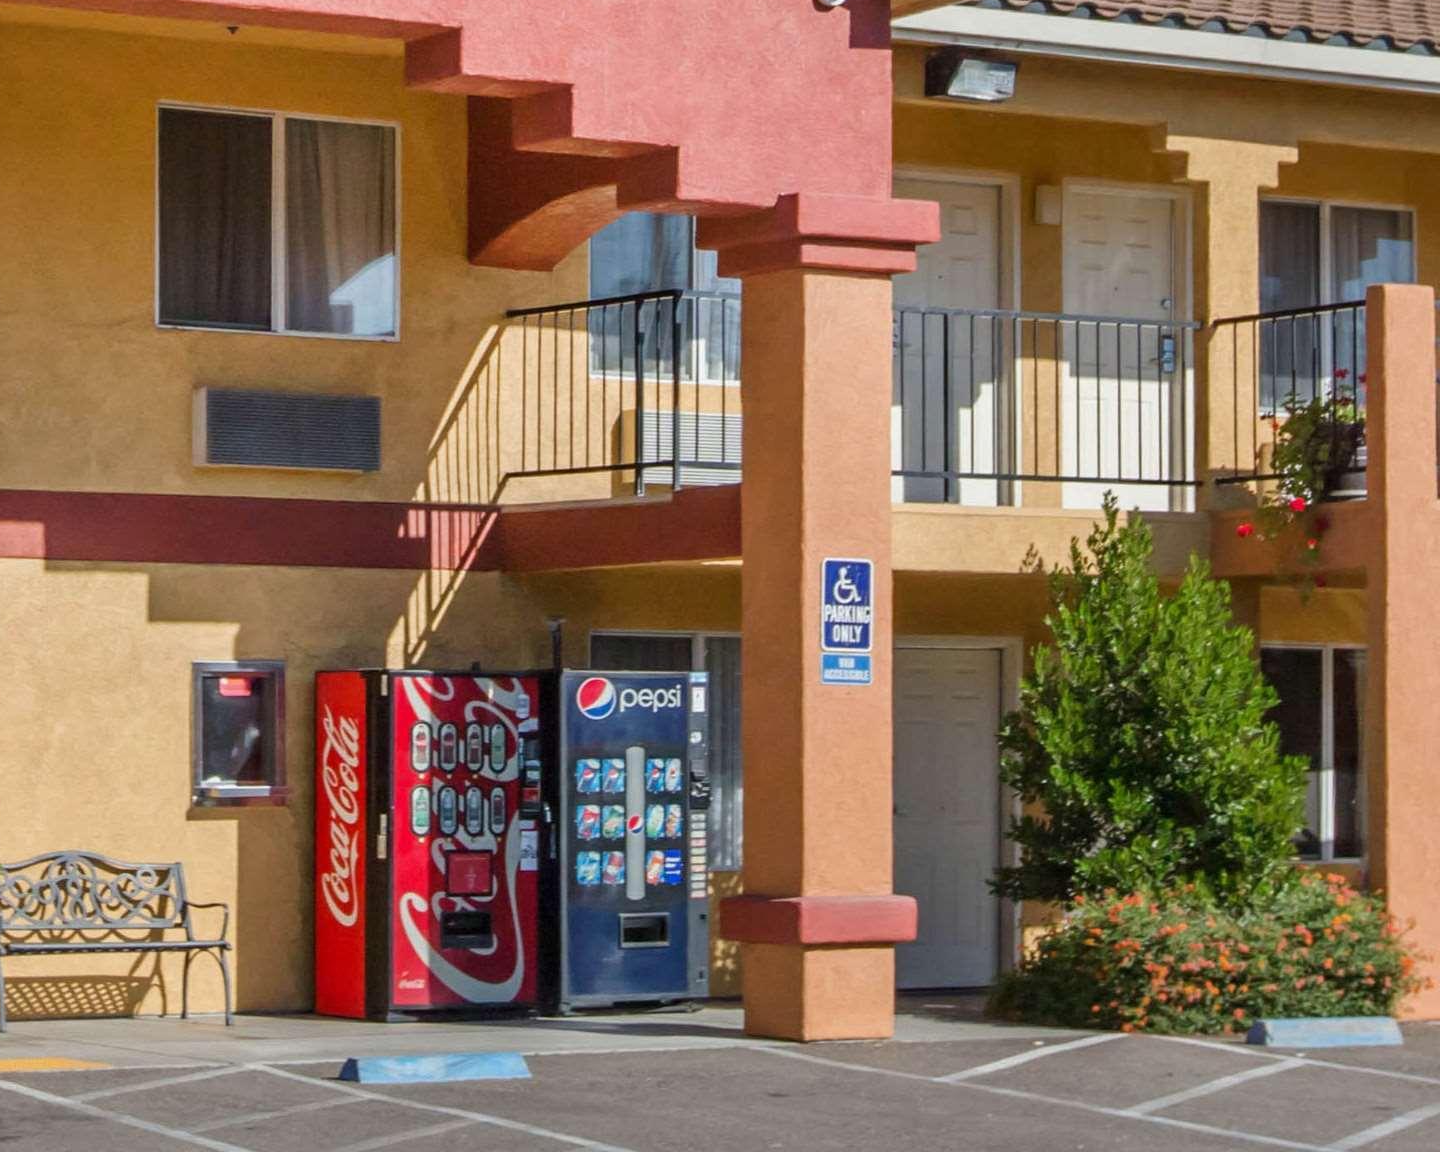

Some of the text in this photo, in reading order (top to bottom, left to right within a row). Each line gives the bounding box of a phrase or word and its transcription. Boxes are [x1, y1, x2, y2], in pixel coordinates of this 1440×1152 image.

[824, 604, 870, 623] PARKING
[832, 624, 862, 643] ONLY
[619, 684, 681, 713] pepsi
[321, 704, 361, 928] Coca-Cola
